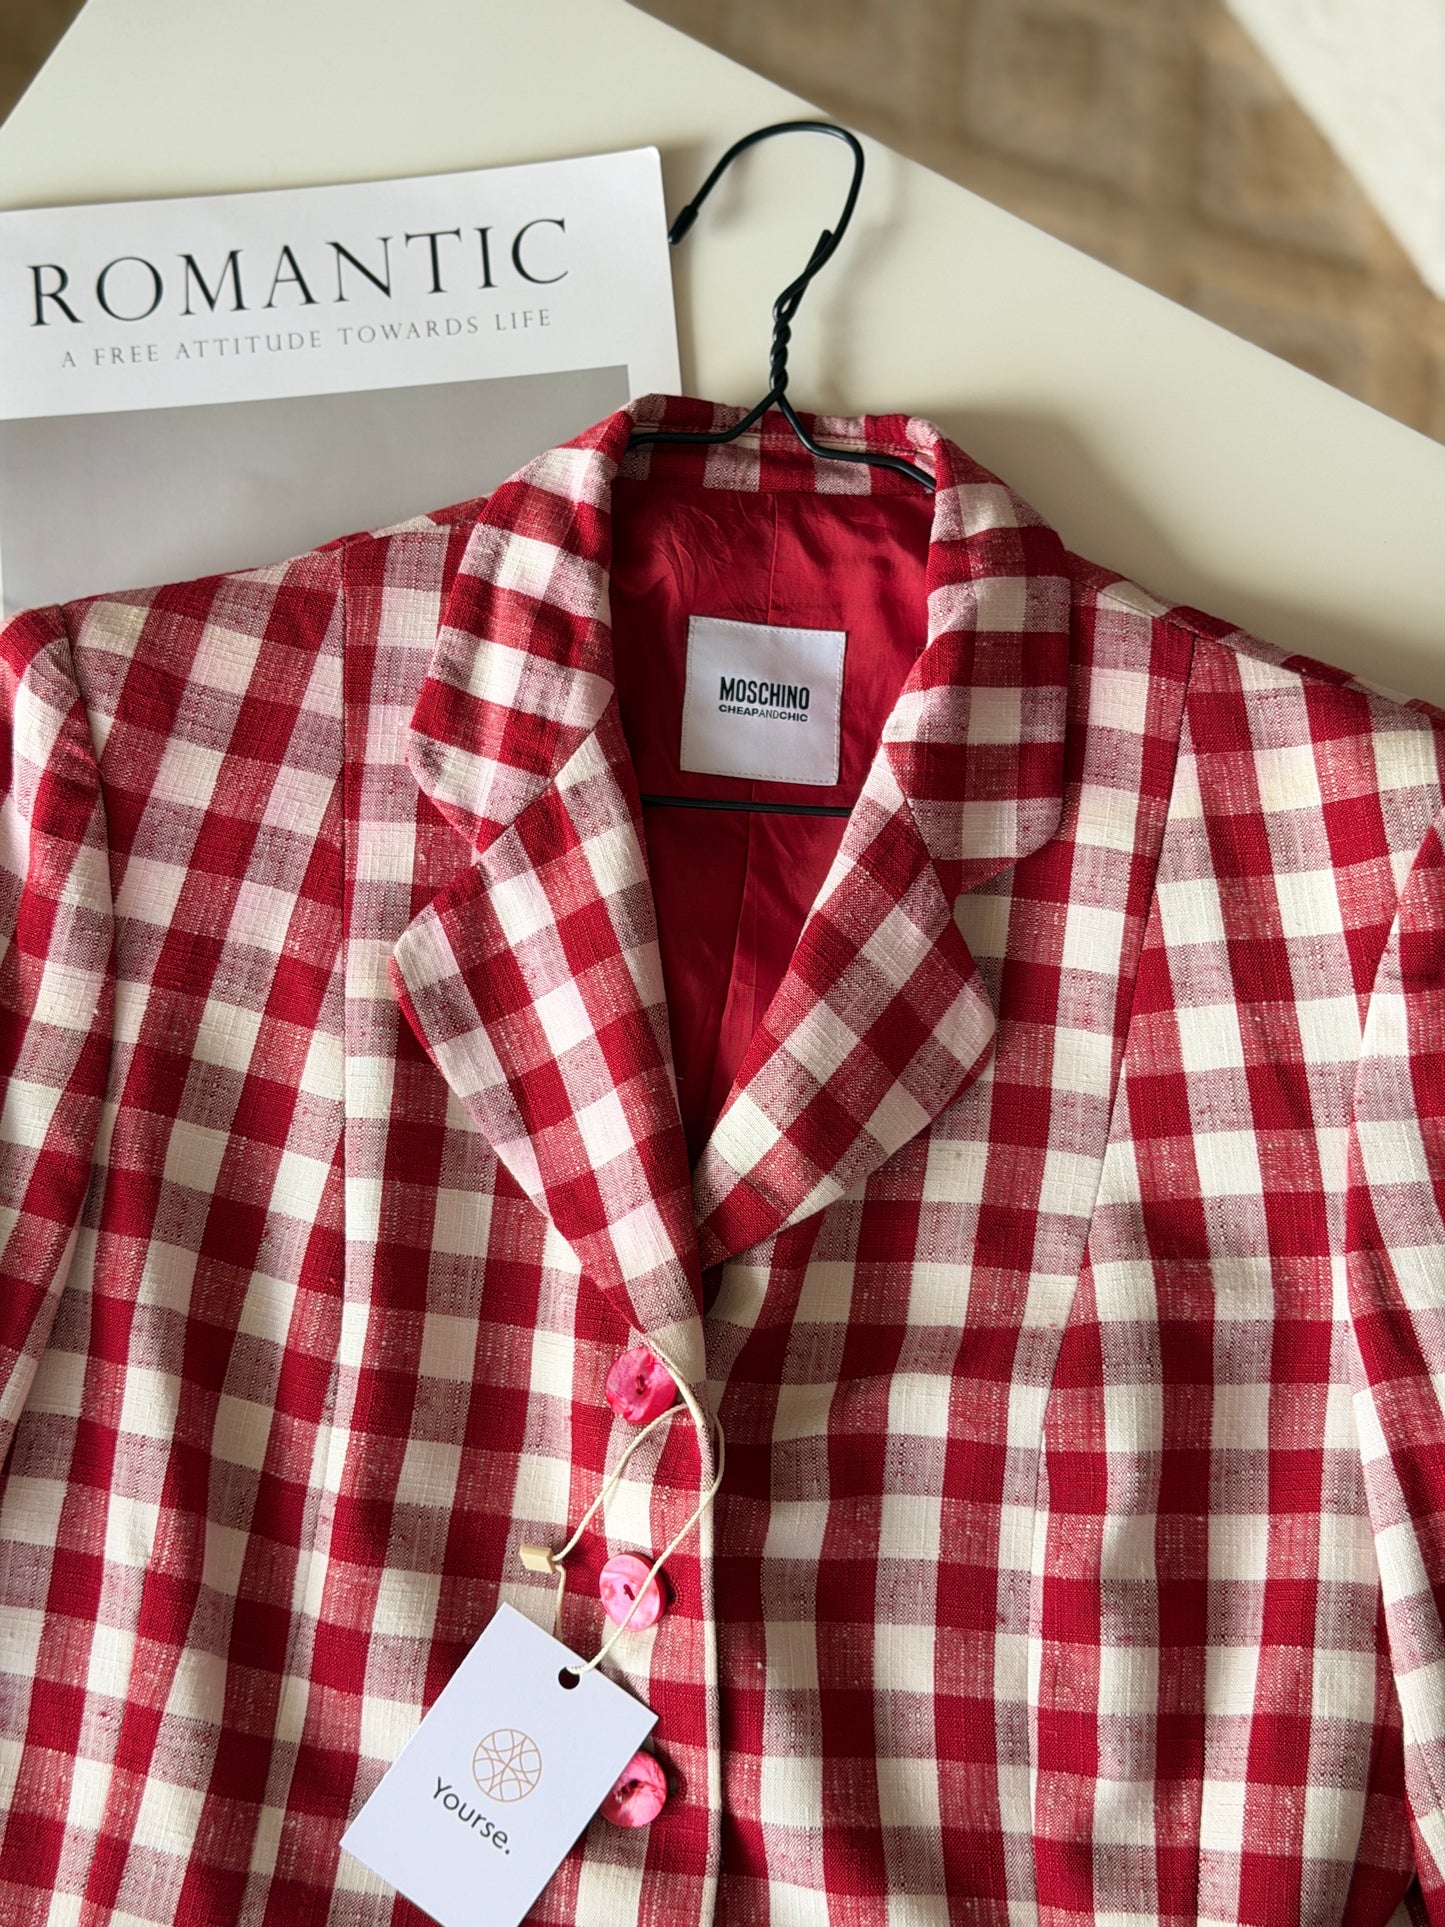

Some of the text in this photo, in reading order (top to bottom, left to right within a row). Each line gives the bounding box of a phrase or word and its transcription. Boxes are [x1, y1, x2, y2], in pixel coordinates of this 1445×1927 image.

[27, 217, 570, 327] ROMANTIC
[61, 308, 552, 368] A FREE ATTITUDE TOWARDS LIFE
[719, 676, 810, 710] MOSCHINO
[432, 1776, 511, 1856] Yourse.
